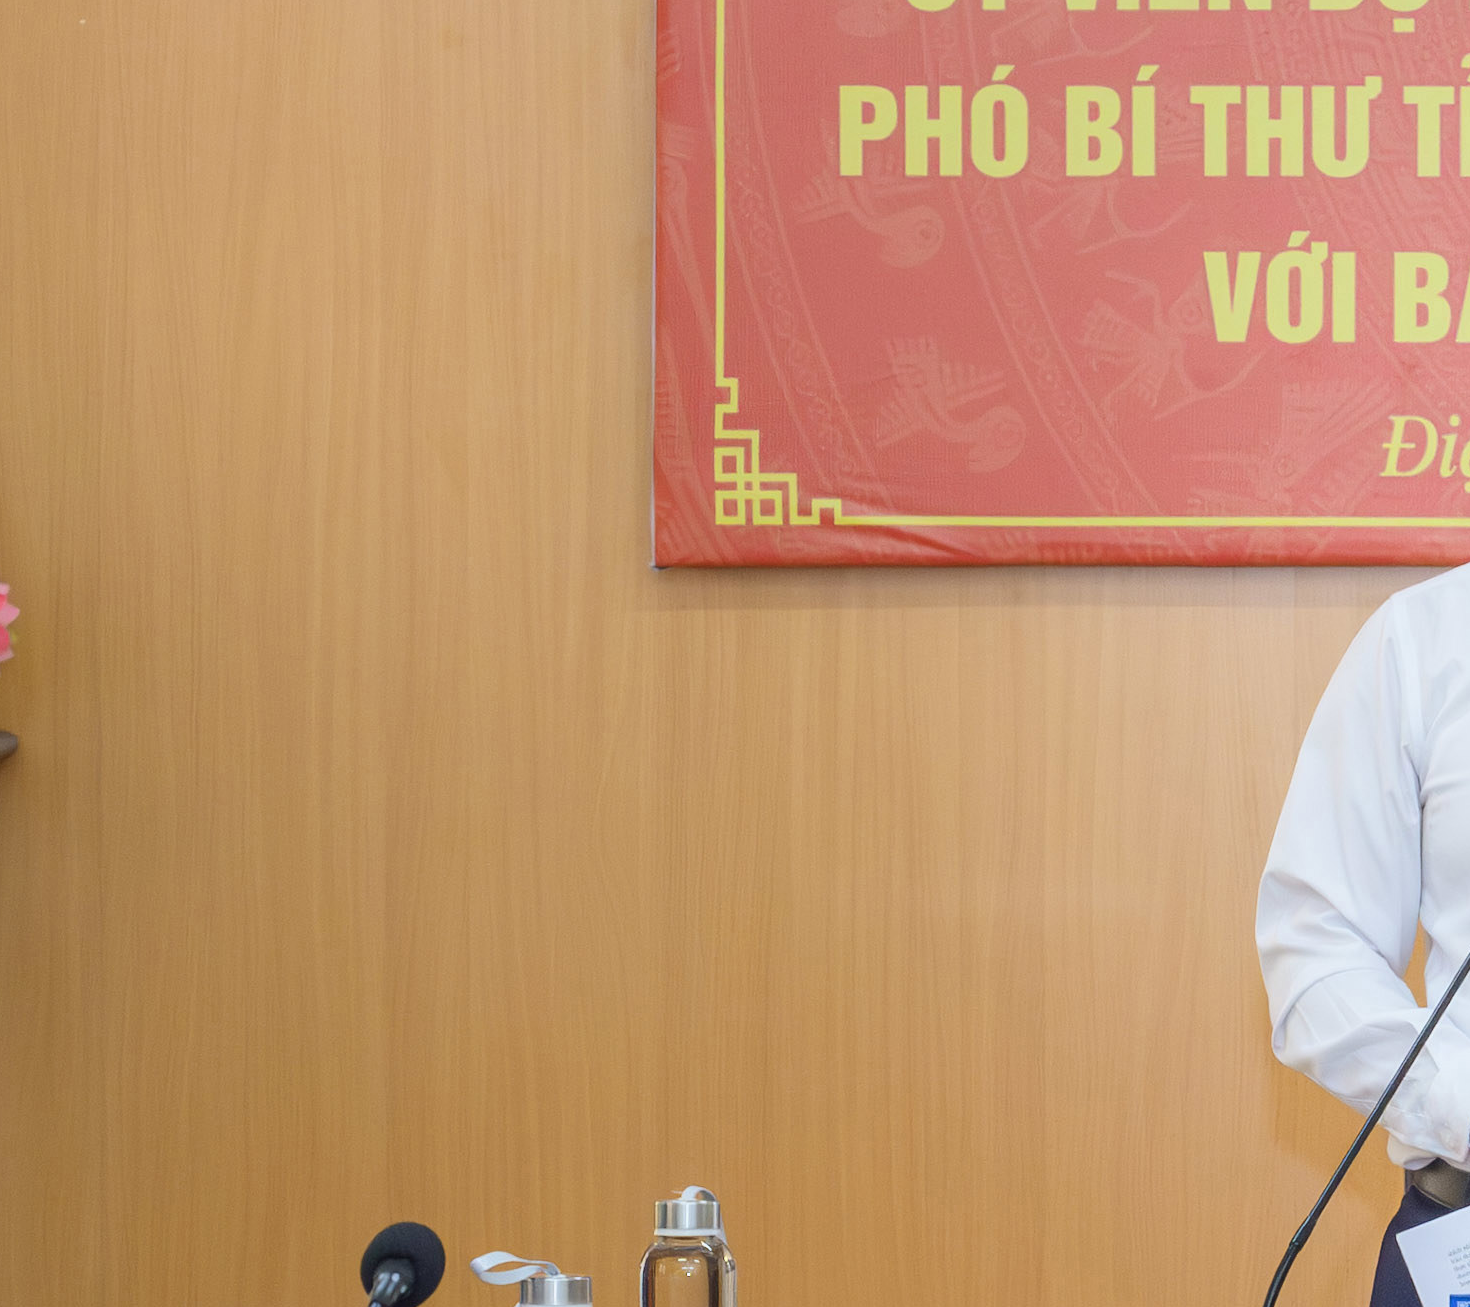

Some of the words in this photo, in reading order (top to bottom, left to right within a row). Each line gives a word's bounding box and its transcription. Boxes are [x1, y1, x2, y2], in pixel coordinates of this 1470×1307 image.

[839, 64, 1029, 178] PHÓ
[1065, 64, 1158, 177] BÍ
[1189, 76, 1382, 178] THƯ
[1203, 231, 1356, 344] VỚI
